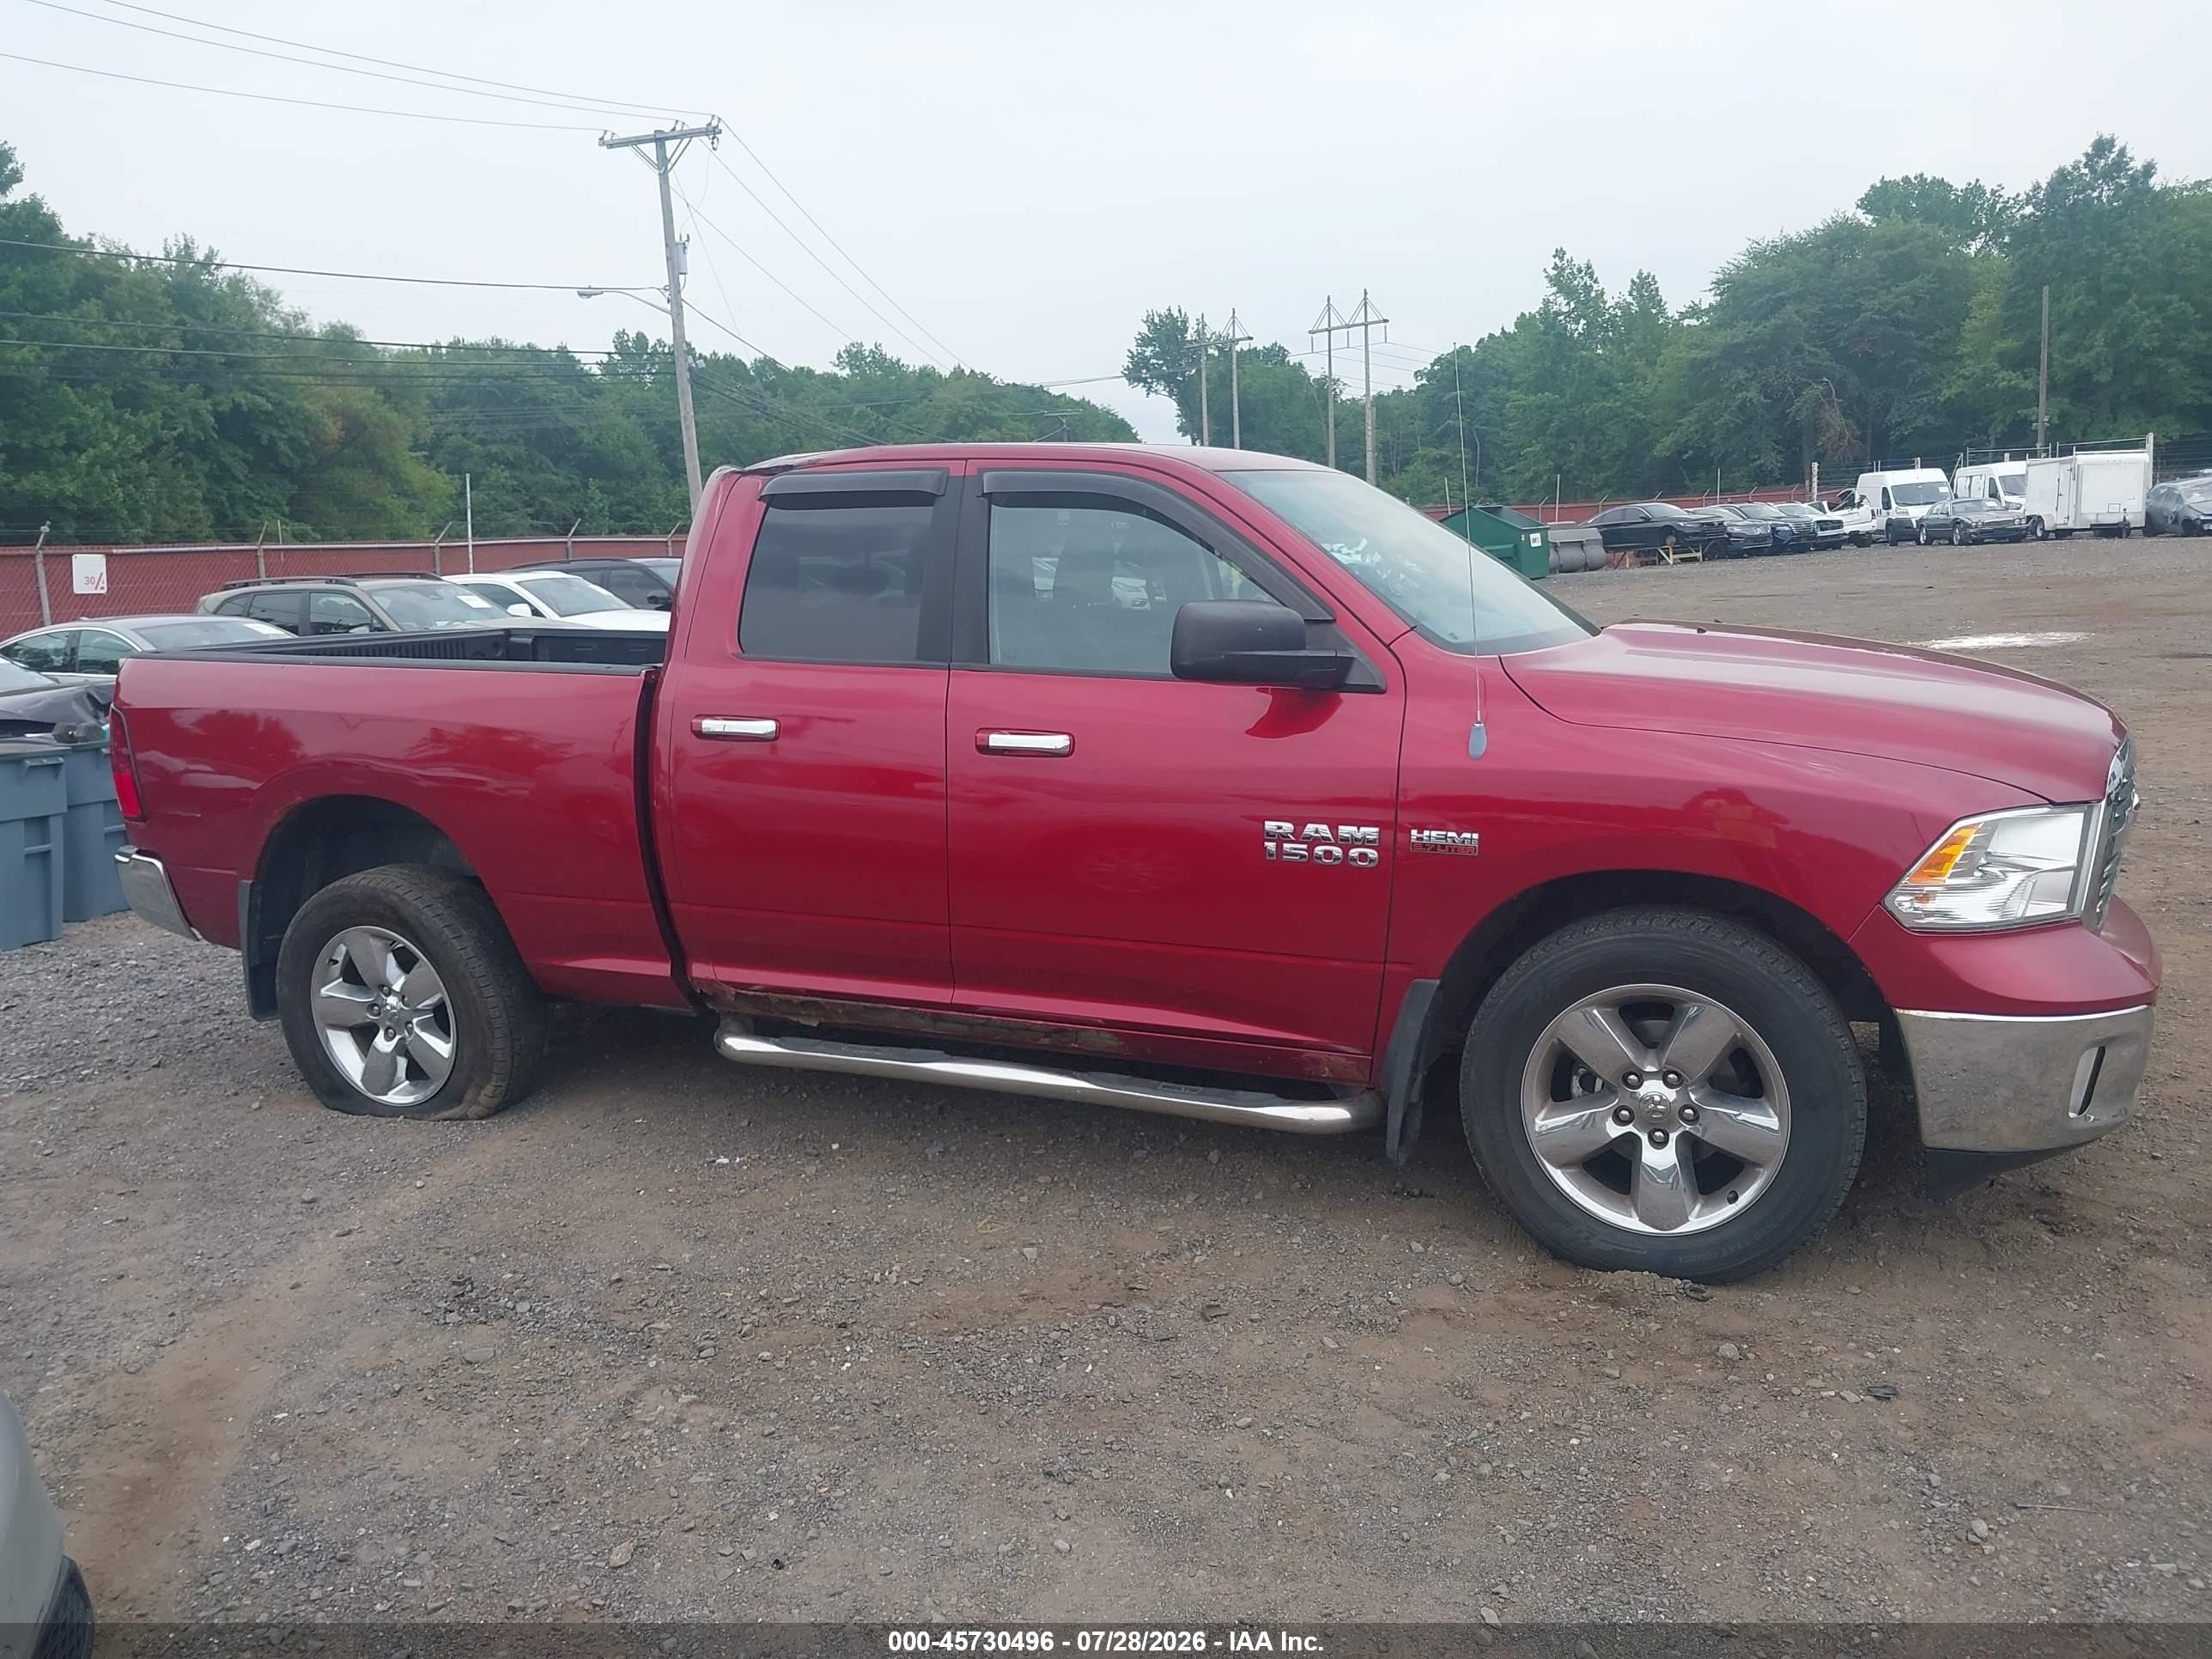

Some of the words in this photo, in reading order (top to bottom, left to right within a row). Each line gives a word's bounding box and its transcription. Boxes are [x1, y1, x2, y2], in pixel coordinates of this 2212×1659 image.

[1264, 820, 1380, 846] RAM
[1411, 830, 1479, 845] HEMI
[1263, 842, 1379, 867] 1500
[1413, 843, 1436, 852] 5.7
[1437, 844, 1476, 854] LITER
